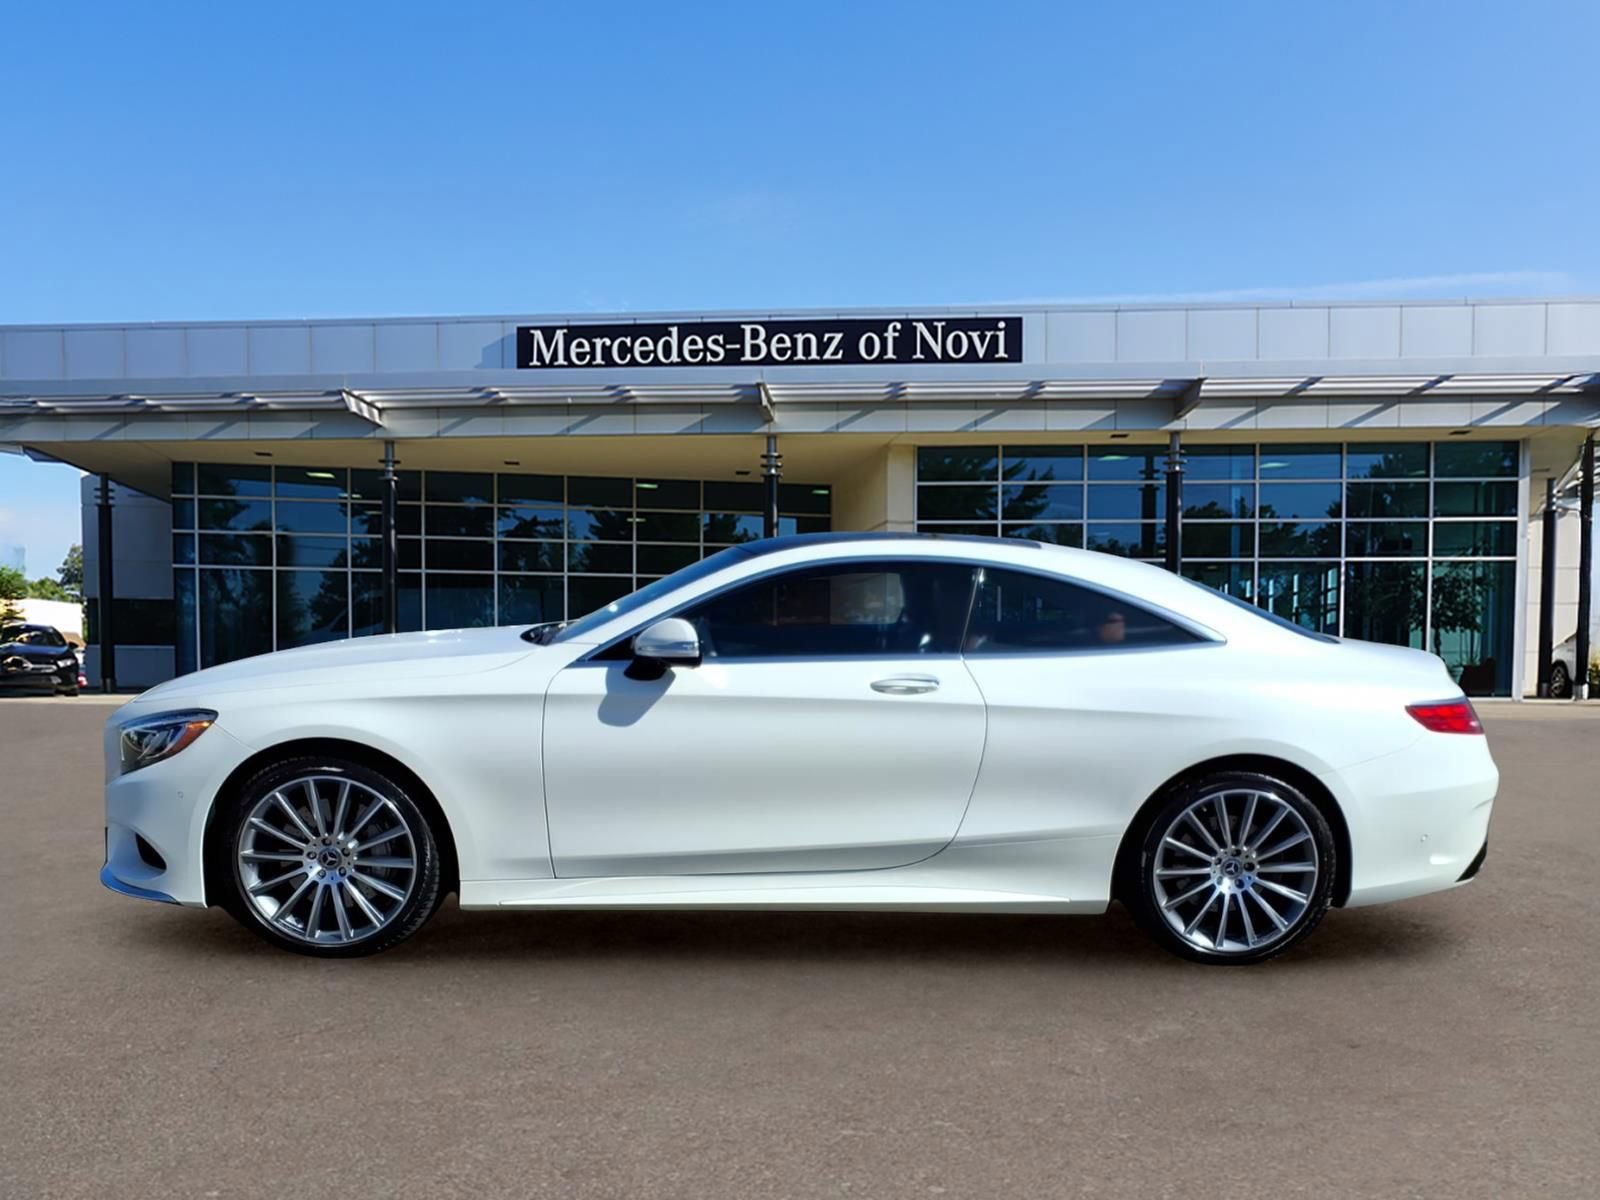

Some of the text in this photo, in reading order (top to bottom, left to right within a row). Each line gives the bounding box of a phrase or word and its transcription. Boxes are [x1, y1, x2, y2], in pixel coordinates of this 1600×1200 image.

[528, 319, 1010, 367] Mercedes-Benz of Novi
